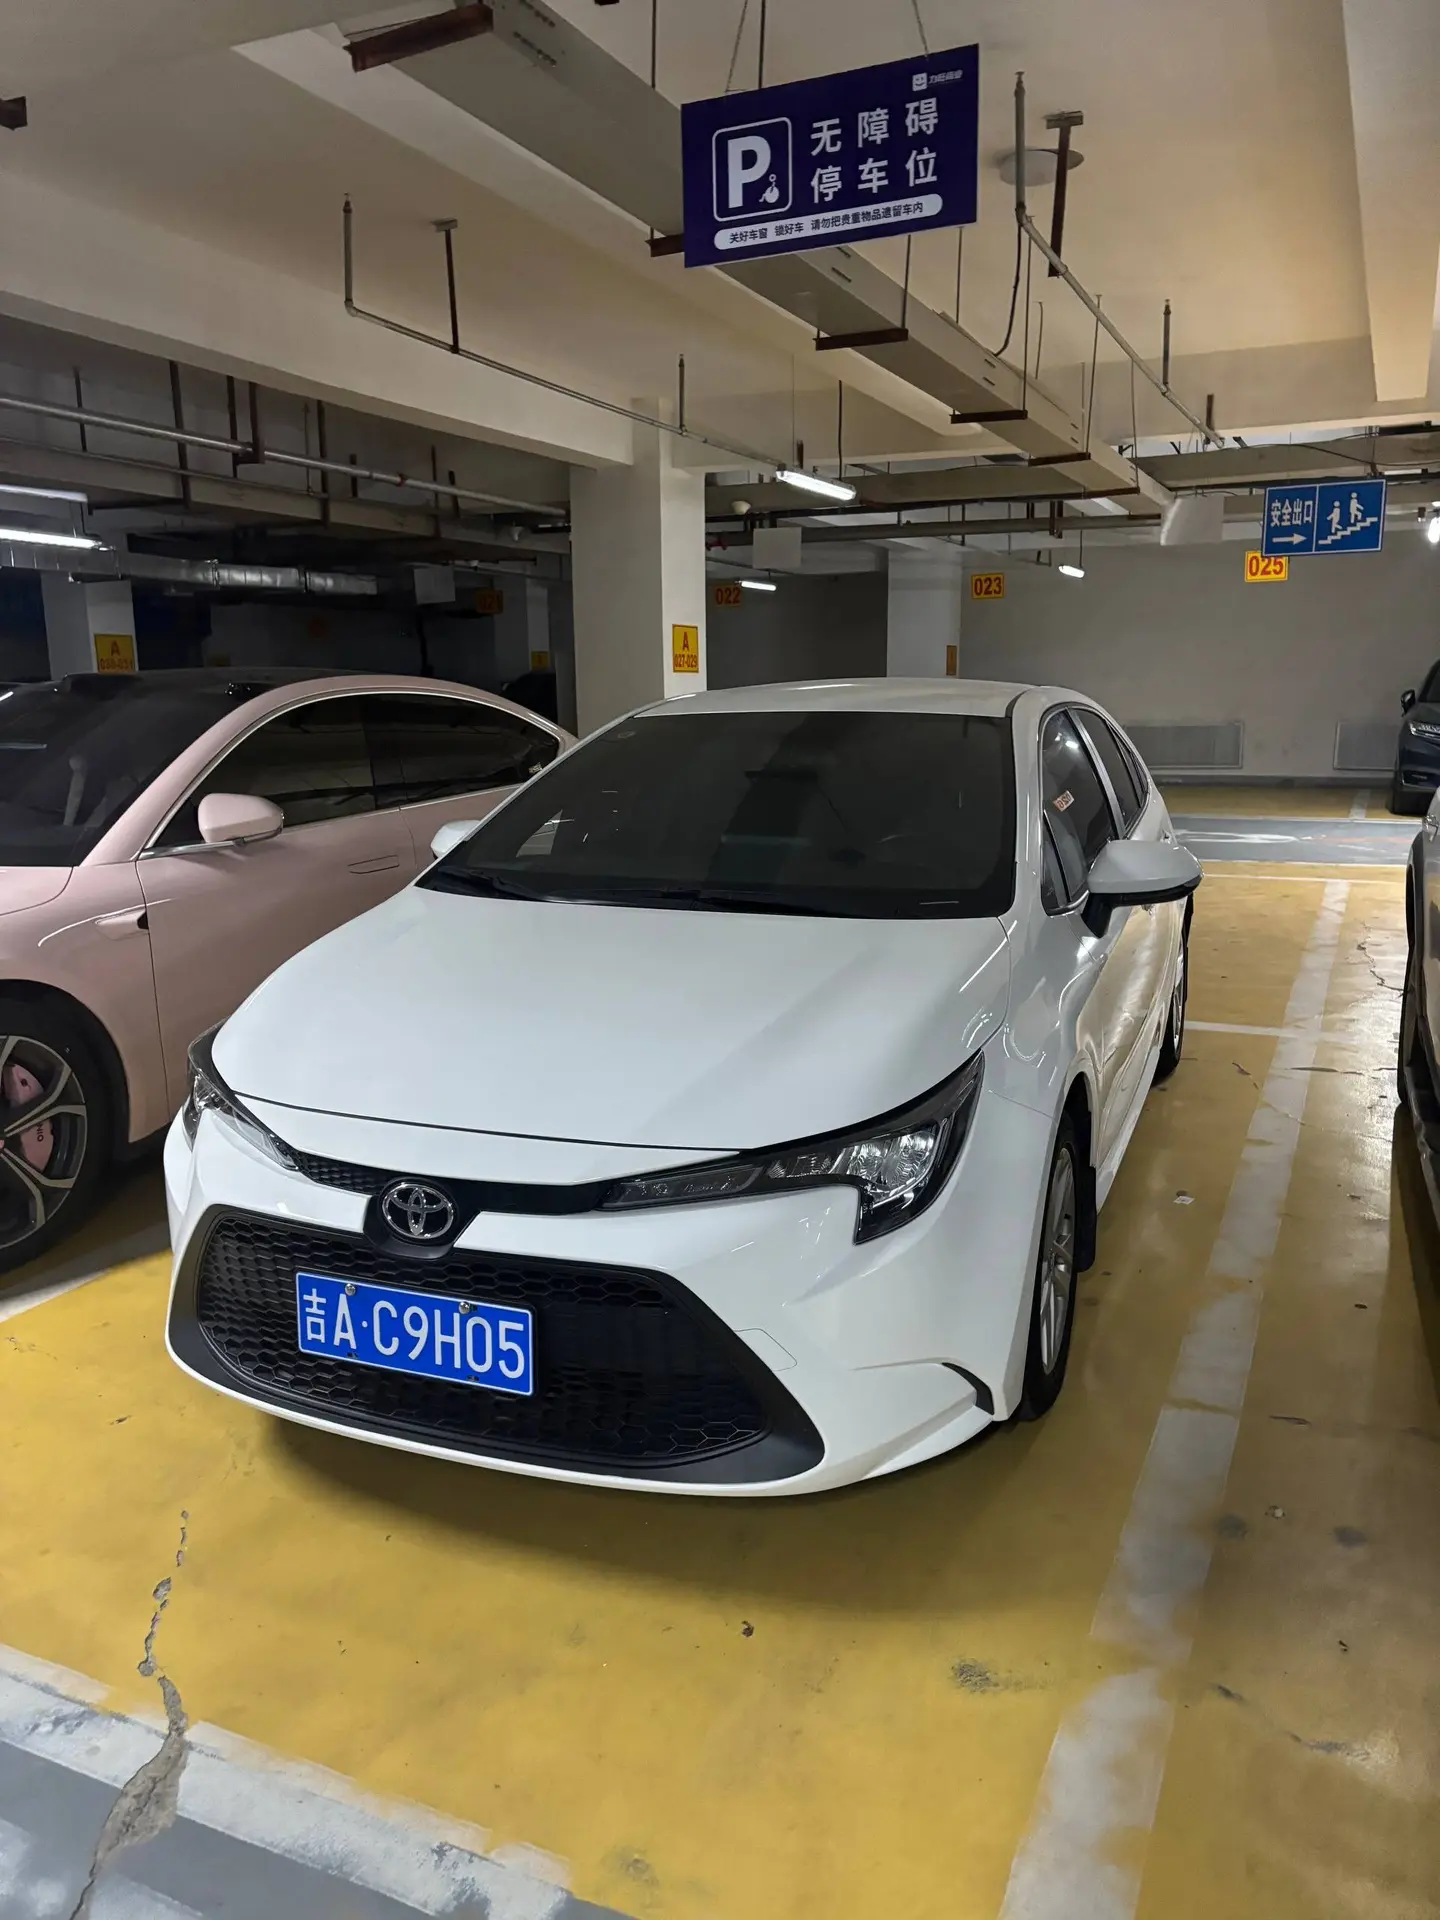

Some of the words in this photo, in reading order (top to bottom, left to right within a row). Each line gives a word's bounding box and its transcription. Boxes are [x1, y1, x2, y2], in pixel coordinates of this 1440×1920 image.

[811, 97, 938, 156] 无障碍
[727, 135, 771, 208] P
[810, 147, 938, 203] 停车位
[729, 227, 768, 244] 关好车窗
[774, 222, 804, 237] 锁好车
[811, 202, 923, 230] 请勿把贵重物品遗留车内
[1270, 498, 1313, 527] 安全出口
[1249, 555, 1284, 577] 025
[715, 587, 740, 605] 022
[974, 577, 1002, 596] 023
[110, 640, 120, 656] A
[682, 632, 690, 651] A
[303, 1288, 525, 1379] 吉A·C9H05
